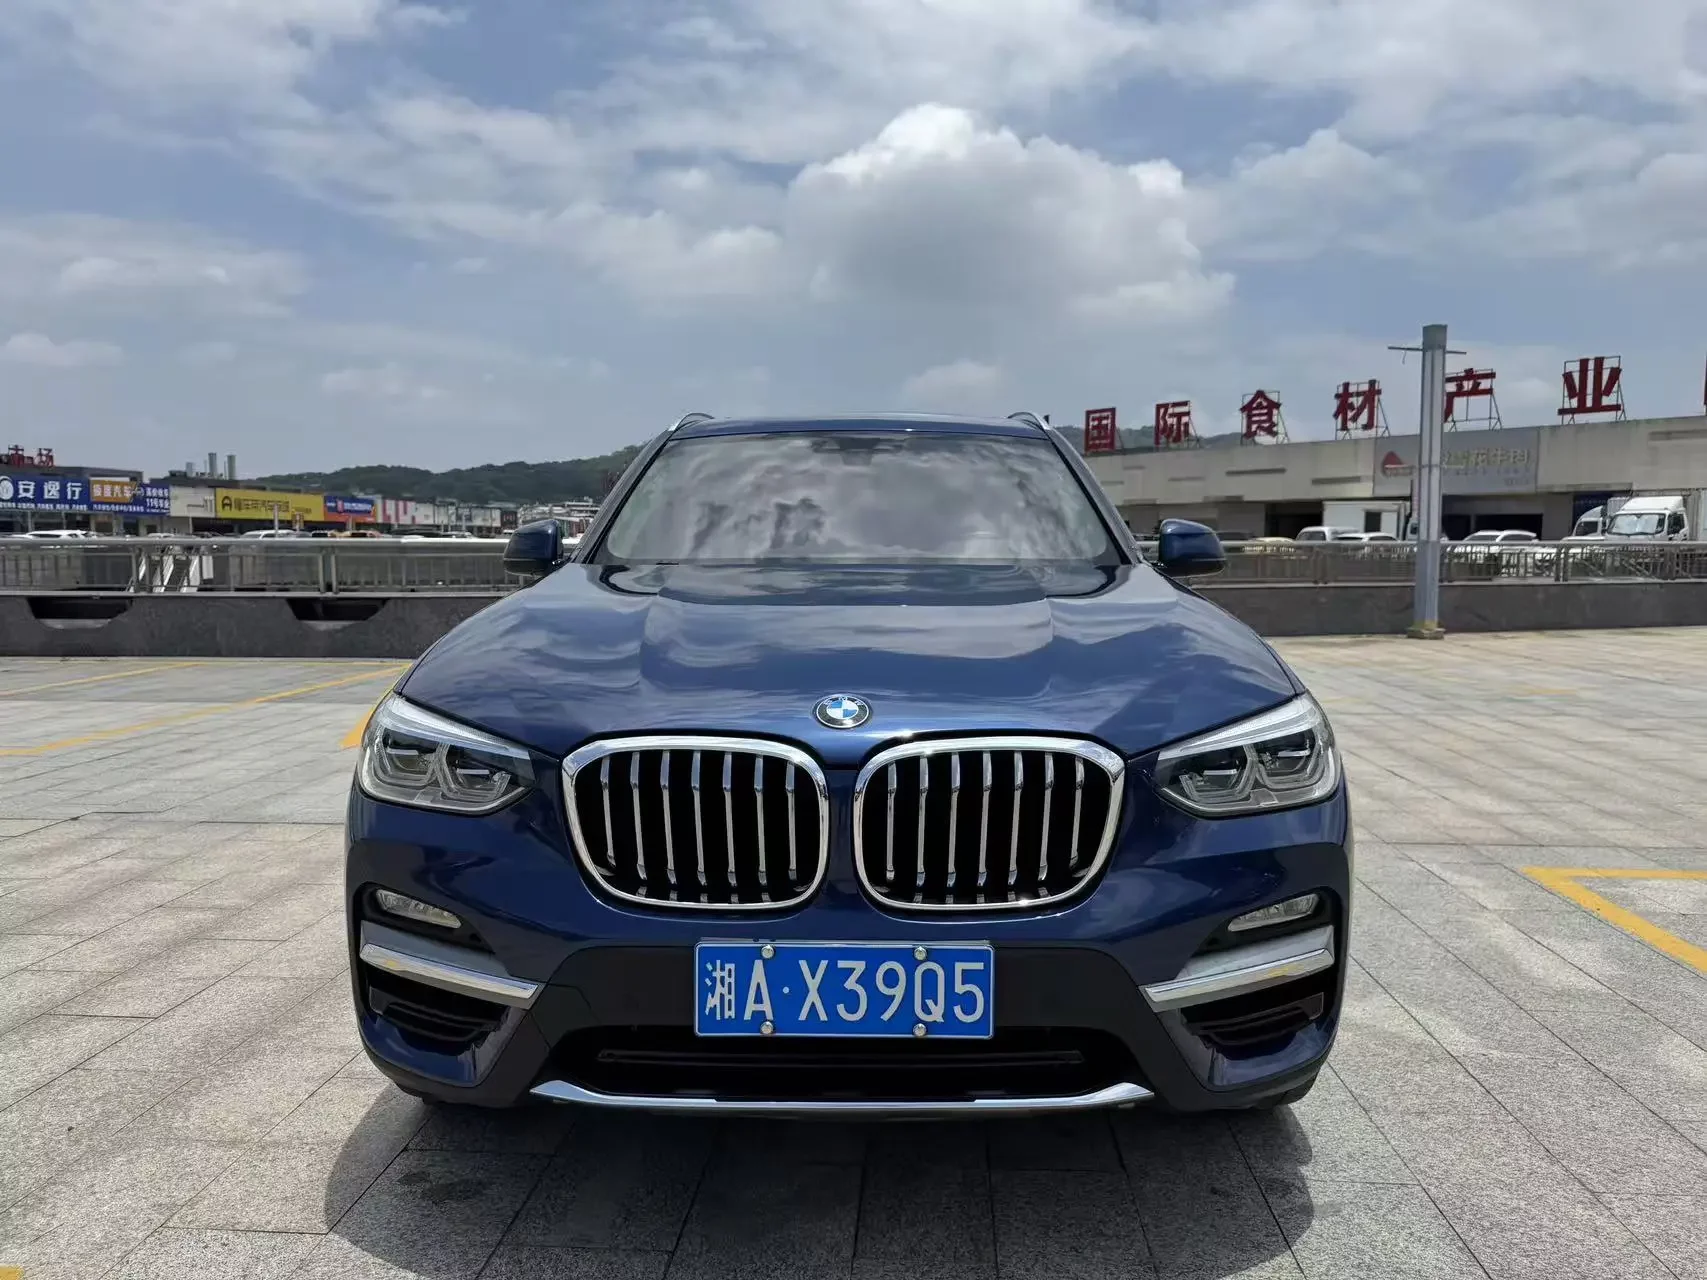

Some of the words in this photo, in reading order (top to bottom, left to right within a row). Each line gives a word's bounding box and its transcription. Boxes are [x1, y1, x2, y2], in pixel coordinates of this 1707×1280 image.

[1084, 356, 1707, 454] 国际食材产业
[17, 480, 83, 500] 安逸行
[705, 959, 985, 1023] 湘A·X39Q5
